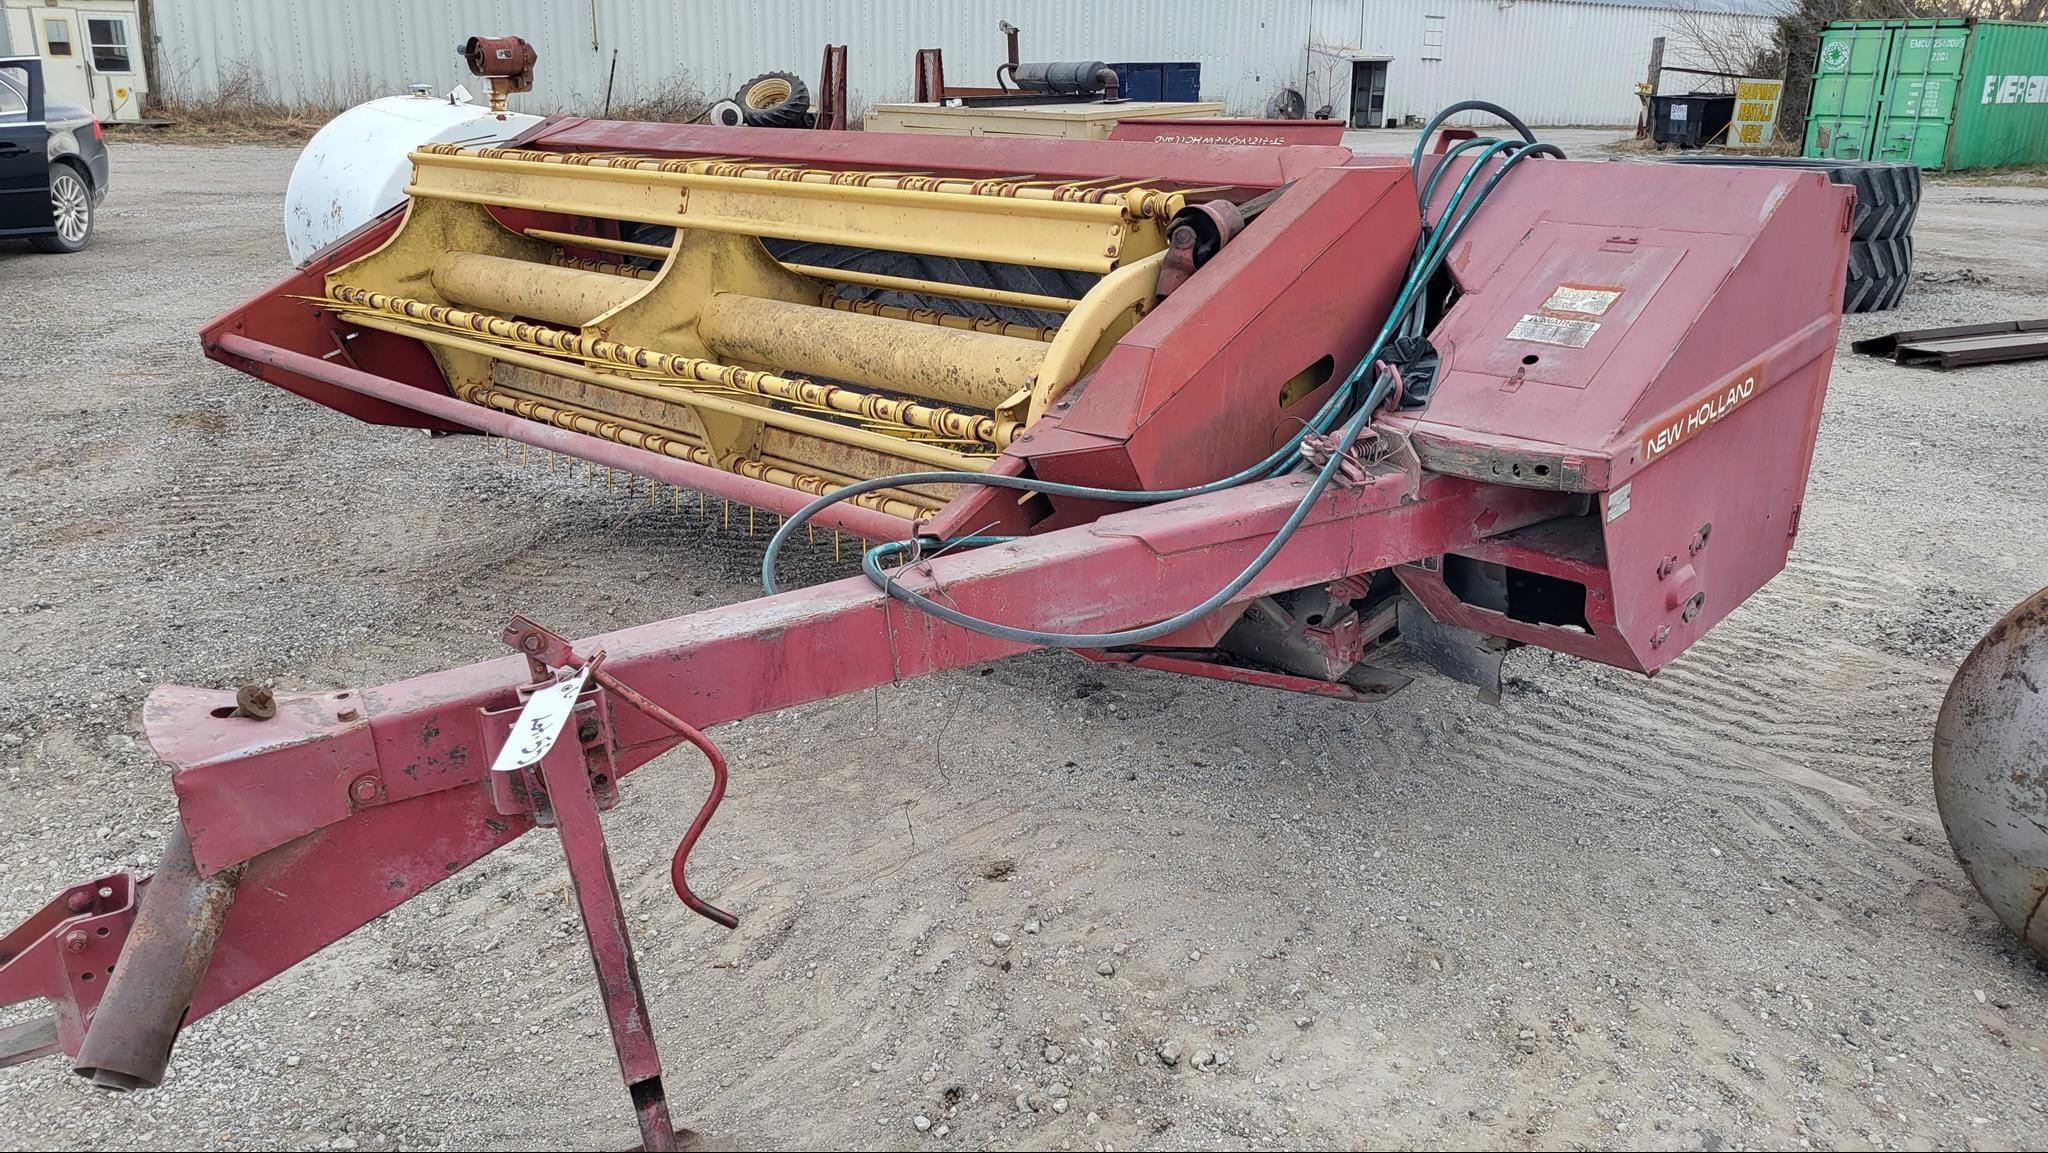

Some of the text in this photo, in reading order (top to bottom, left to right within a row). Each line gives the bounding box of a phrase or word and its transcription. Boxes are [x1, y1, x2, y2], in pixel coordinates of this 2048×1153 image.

[1738, 82, 1781, 101] EQUIPMENT
[1737, 103, 1774, 122] RENTALS
[1739, 124, 1763, 143] HERE
[1646, 377, 1755, 460] NEW HOLLAND
